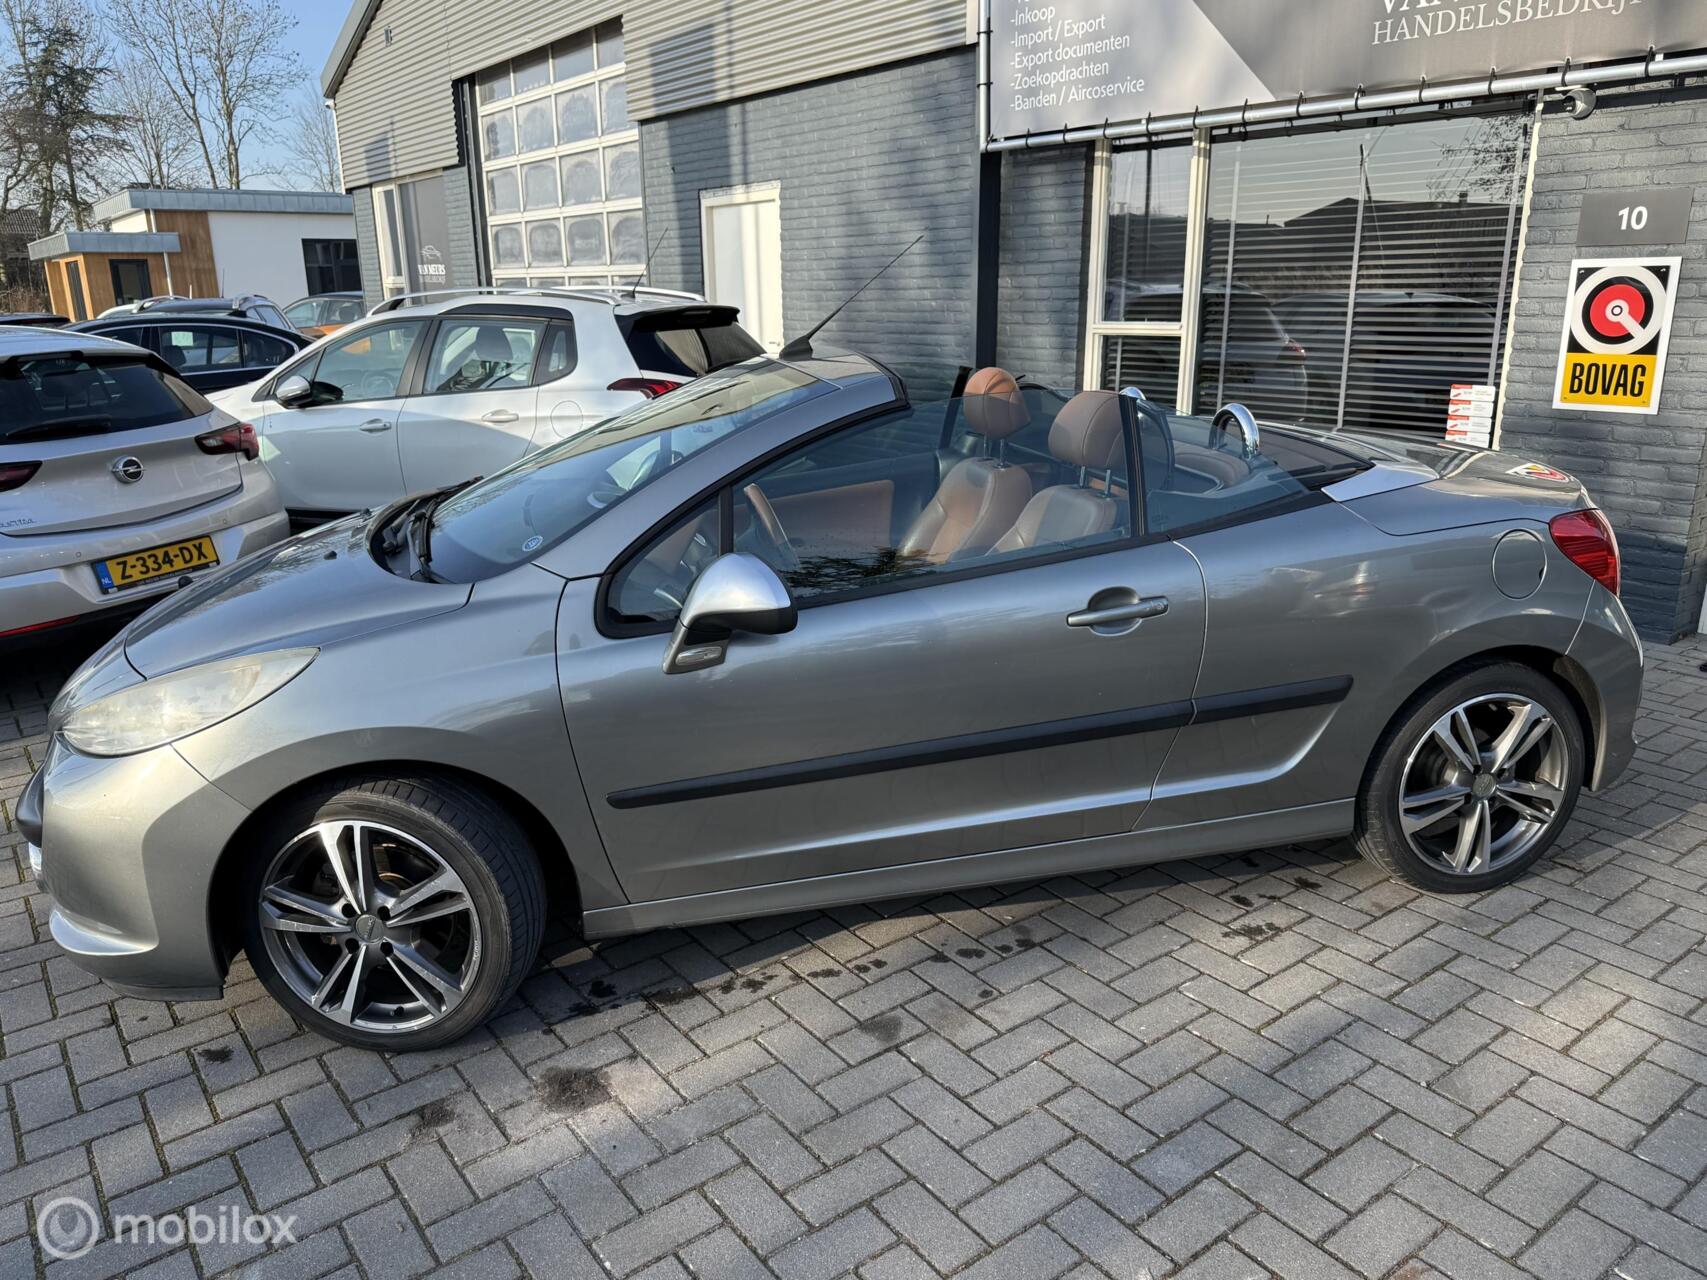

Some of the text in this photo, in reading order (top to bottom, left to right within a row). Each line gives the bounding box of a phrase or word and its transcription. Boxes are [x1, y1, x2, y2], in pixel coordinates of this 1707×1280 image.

[1010, 6, 1056, 26] -Inkoop
[1010, 25, 1053, 49] -Import
[1064, 14, 1106, 39] Export
[1372, 0, 1642, 45] HANDELSBEDR
[1010, 34, 1130, 71] -Export documenten
[1010, 60, 1109, 90] -Zoekopdrachten
[1010, 90, 1057, 111] -Banden
[1067, 76, 1145, 103] Aircoservice
[1618, 206, 1648, 231] 10
[1569, 362, 1647, 398] BOVAG
[115, 541, 209, 581] Z-334-DX
[101, 577, 112, 585] NL
